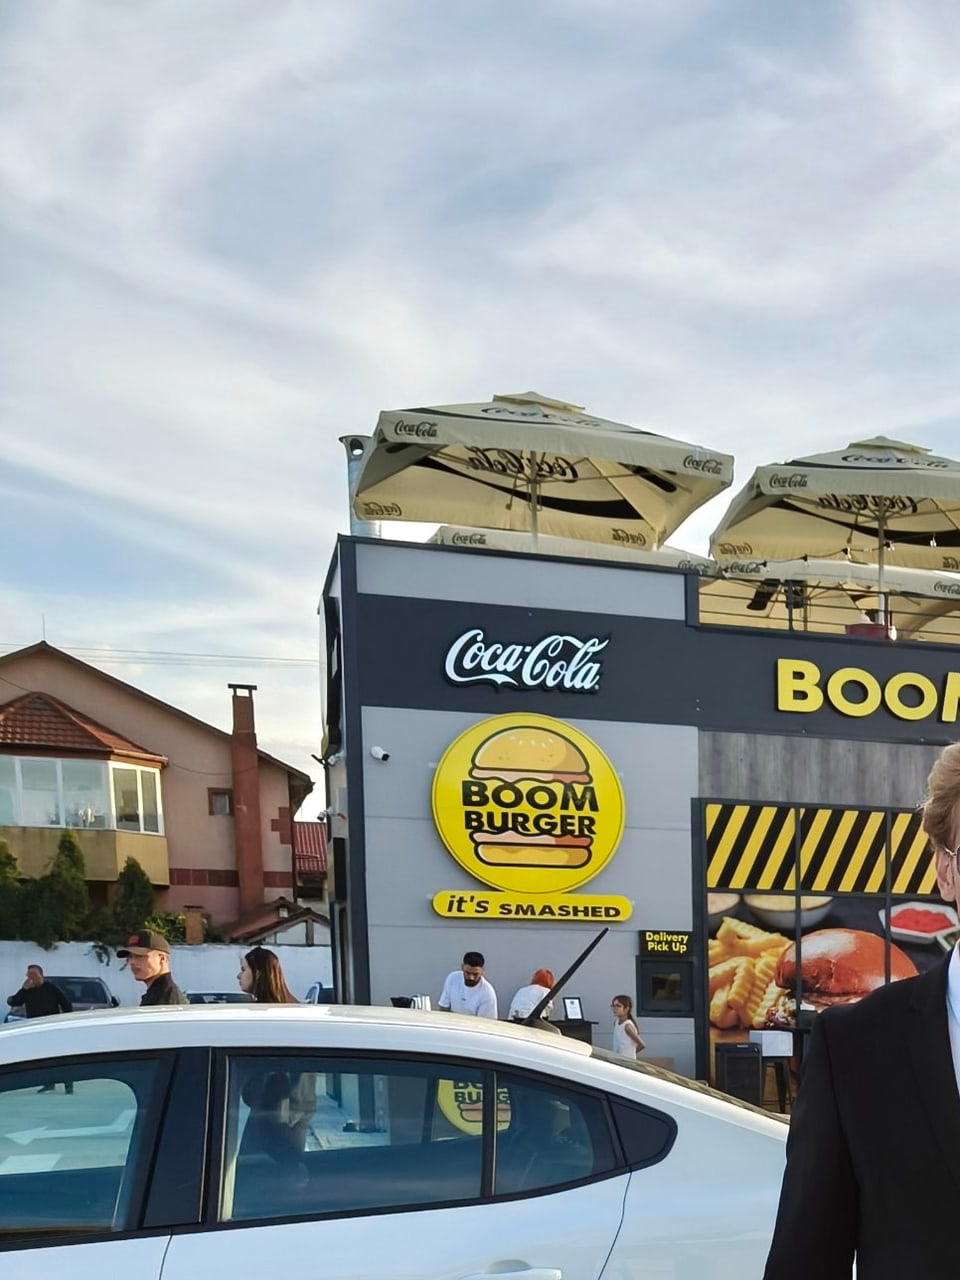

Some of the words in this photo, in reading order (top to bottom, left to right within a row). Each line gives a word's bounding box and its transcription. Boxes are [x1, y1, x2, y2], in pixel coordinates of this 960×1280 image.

[445, 629, 610, 690] Coca-Cola
[462, 781, 600, 812] BOOM
[464, 811, 597, 836] BURGER
[447, 895, 490, 914] it's
[499, 903, 621, 918] SMASHED
[645, 931, 689, 944] Delivery
[647, 942, 670, 951] Pick
[672, 942, 688, 954] Up
